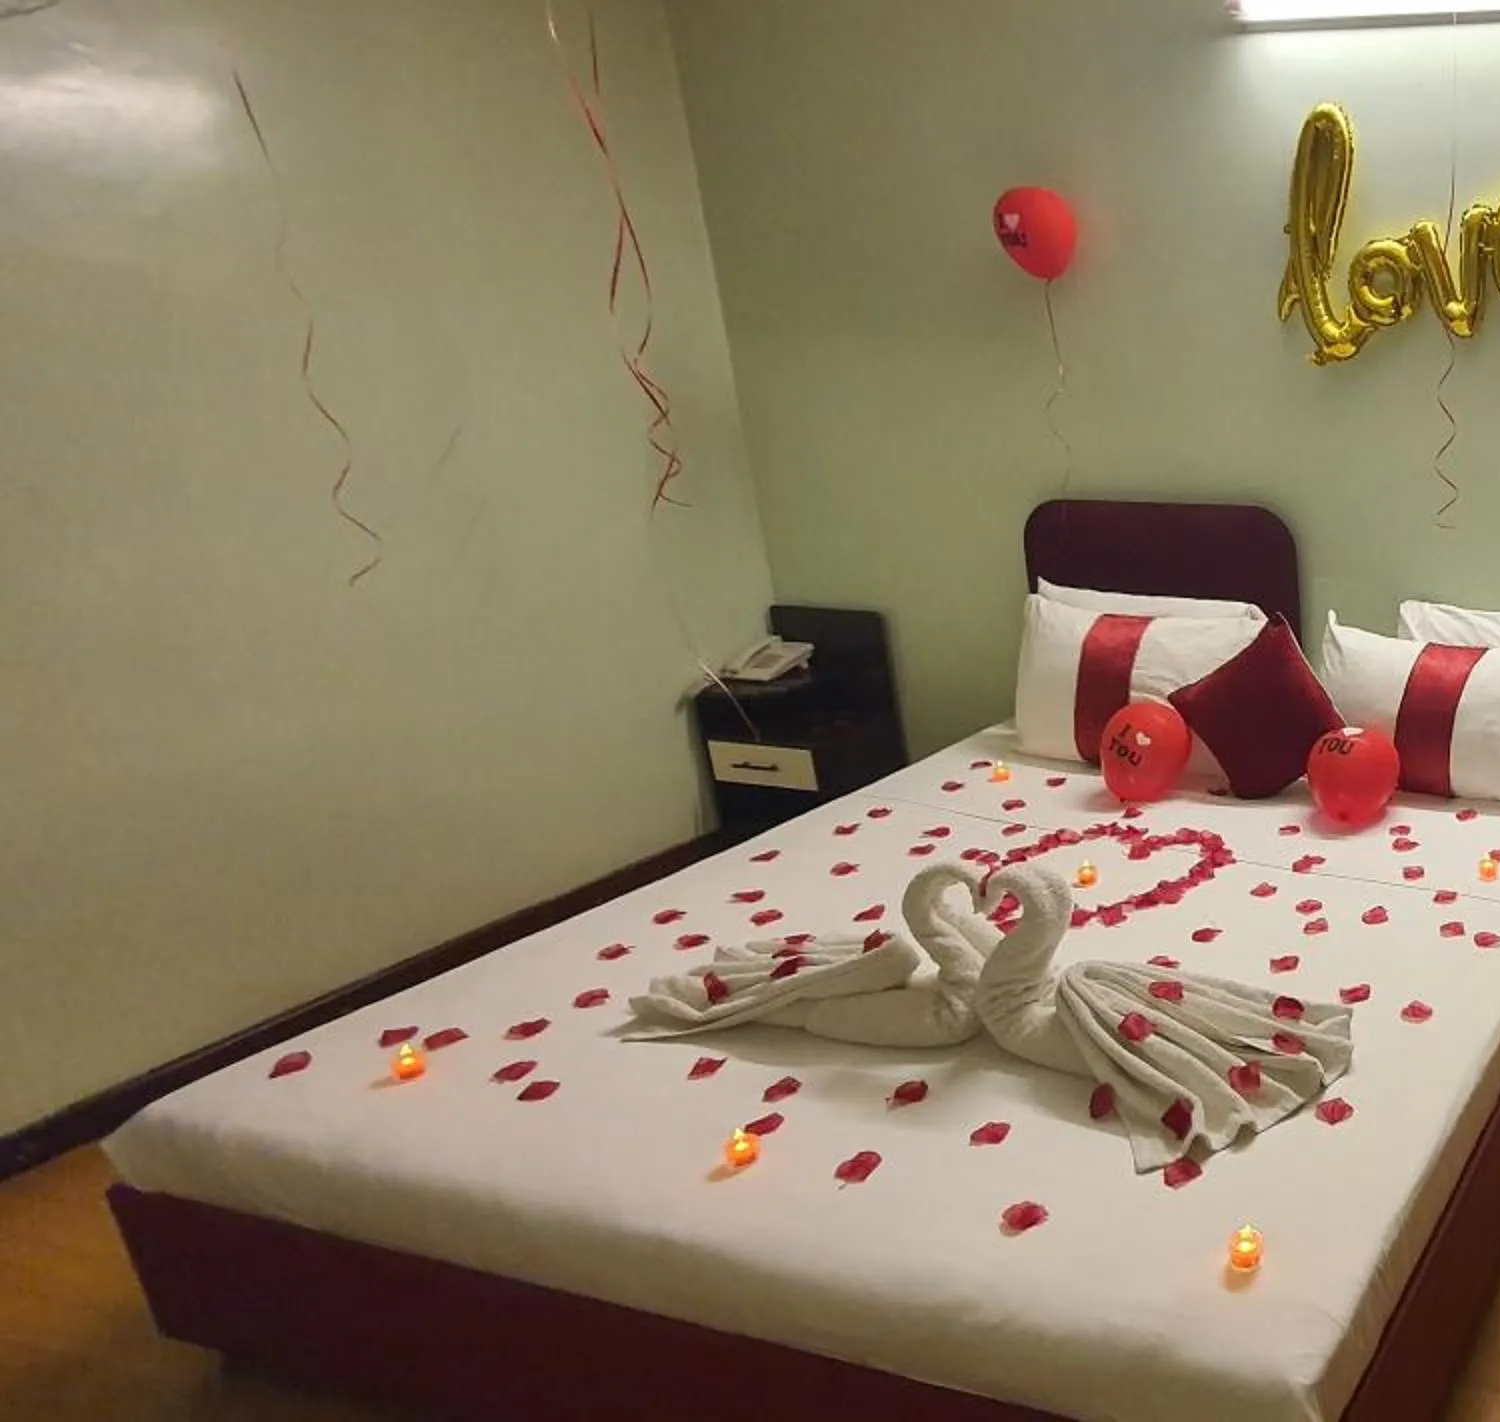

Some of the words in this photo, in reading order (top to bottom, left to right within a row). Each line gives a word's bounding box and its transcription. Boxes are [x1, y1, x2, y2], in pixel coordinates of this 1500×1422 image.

[1118, 723, 1132, 737] I
[1107, 736, 1142, 767] YOU
[1318, 737, 1355, 755] YOU
